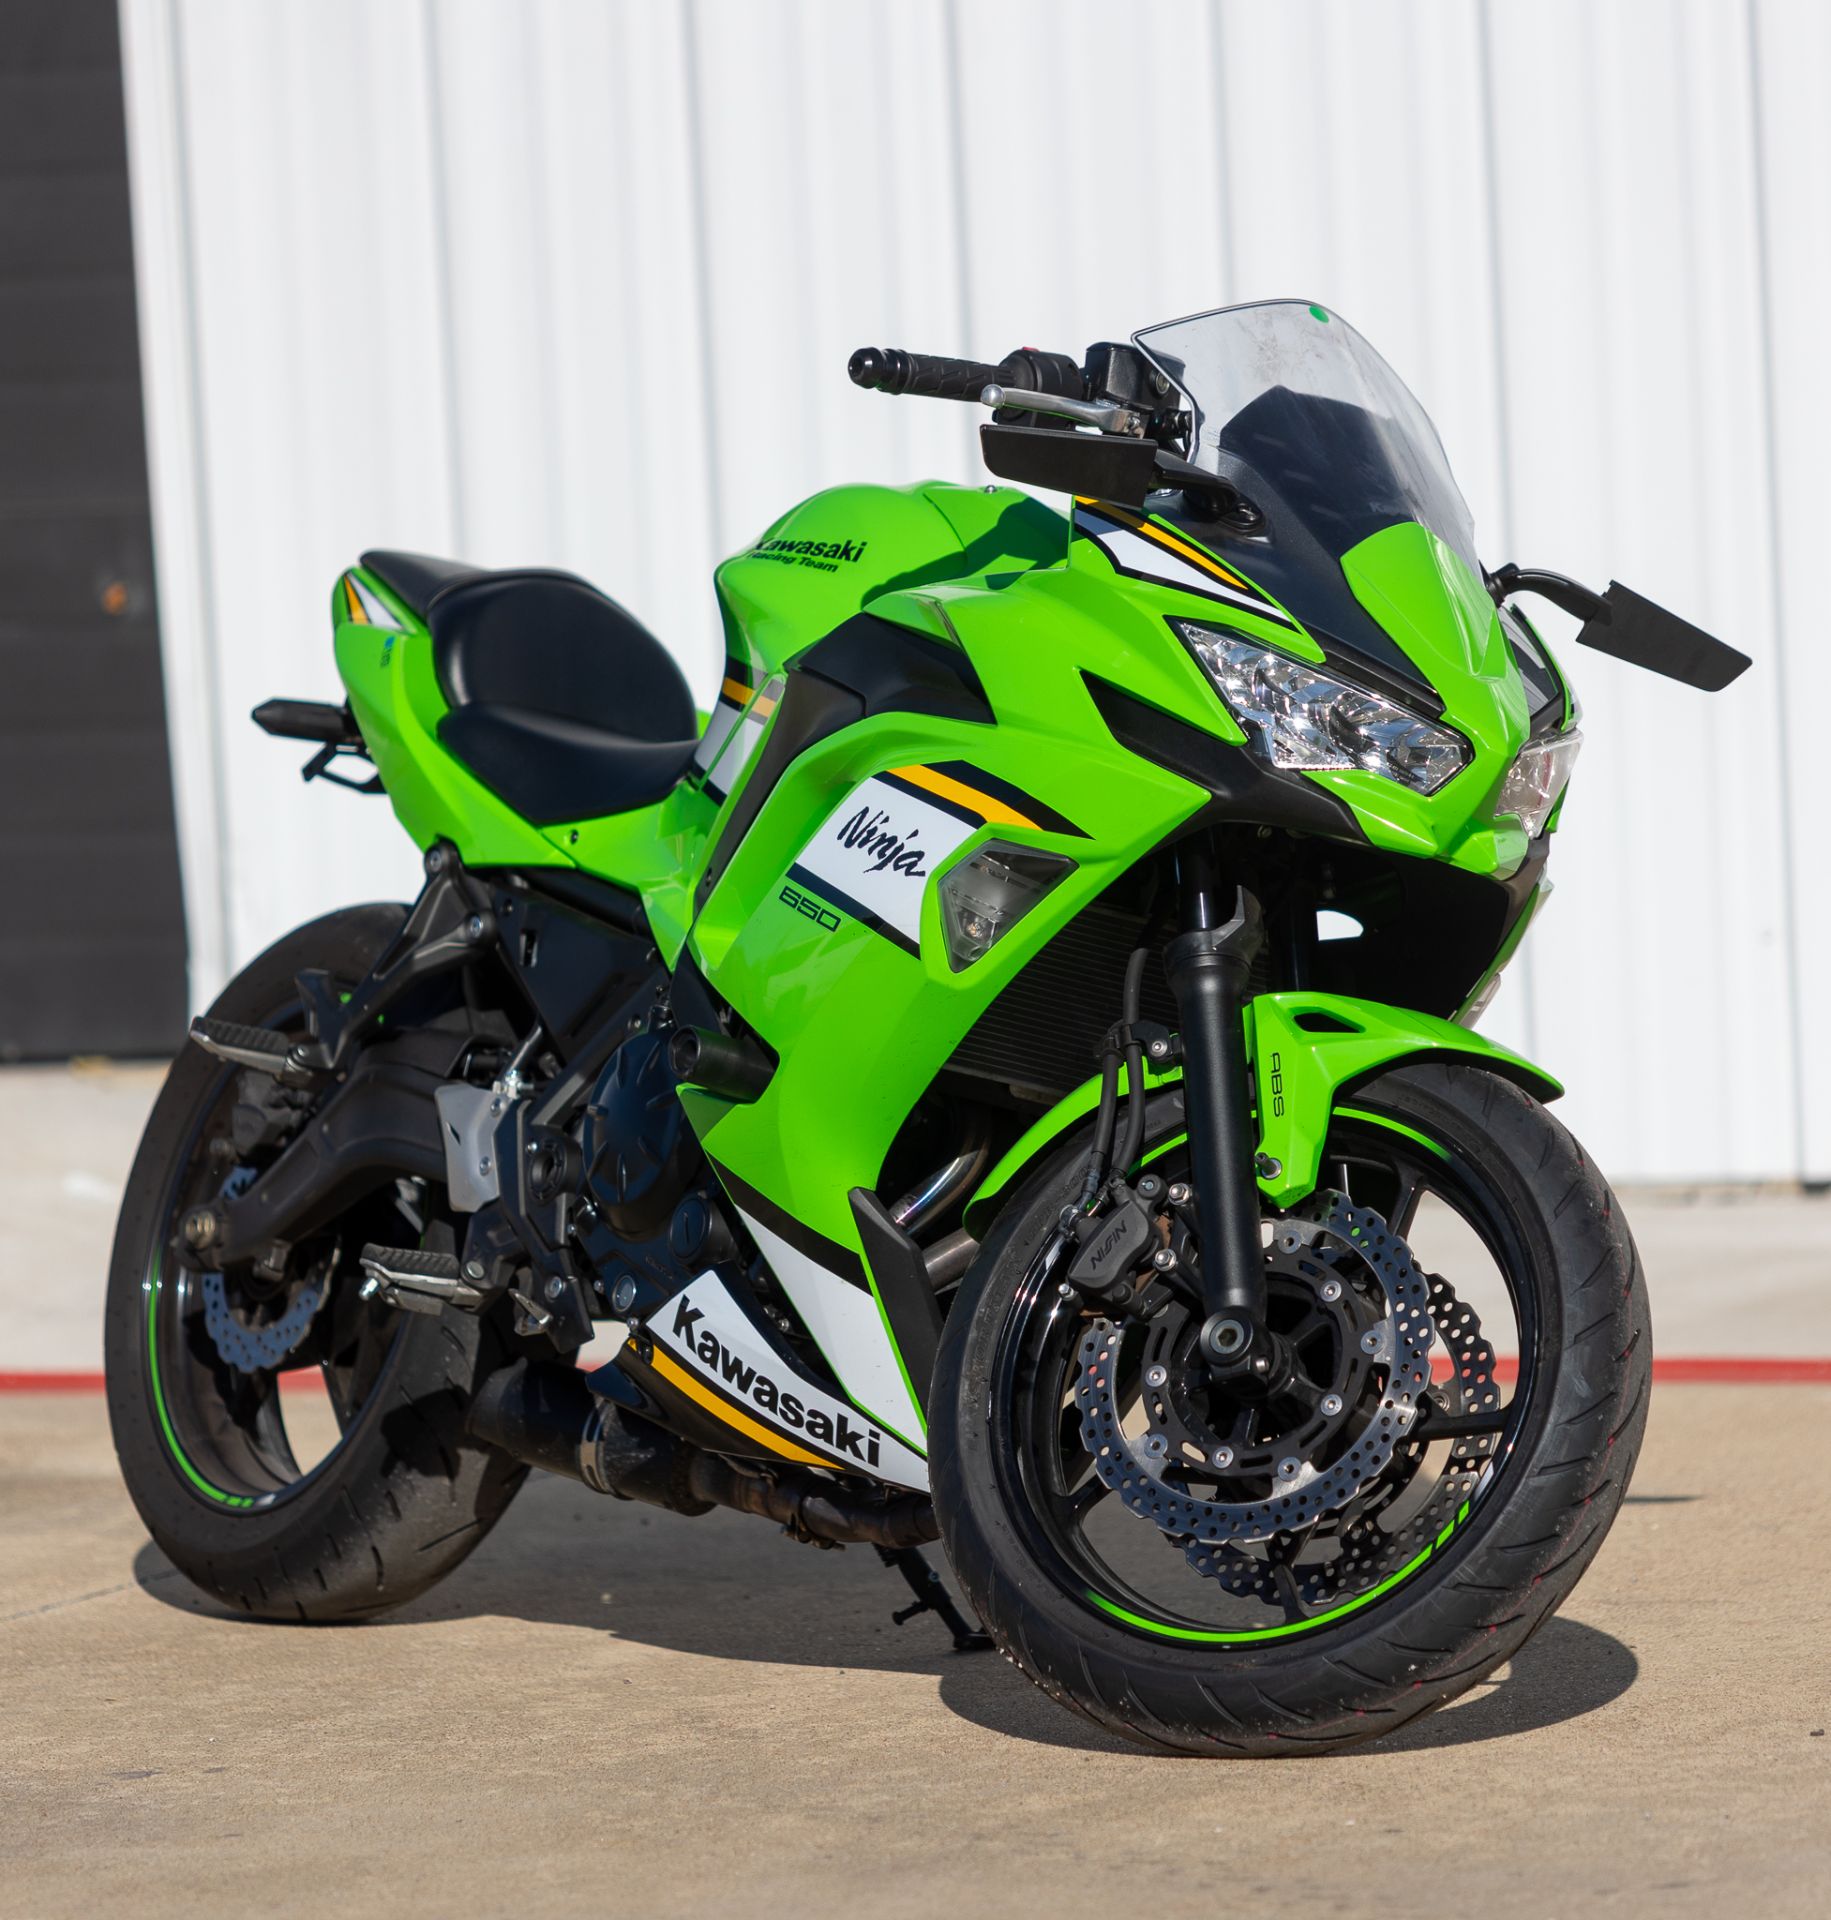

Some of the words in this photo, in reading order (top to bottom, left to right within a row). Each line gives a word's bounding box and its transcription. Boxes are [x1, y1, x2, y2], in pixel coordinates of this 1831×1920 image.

[799, 557, 838, 573] Team
[837, 806, 926, 877] Ninja
[779, 886, 841, 932] 650
[1271, 1052, 1285, 1117] ABS
[672, 1294, 881, 1468] Kawasaki
